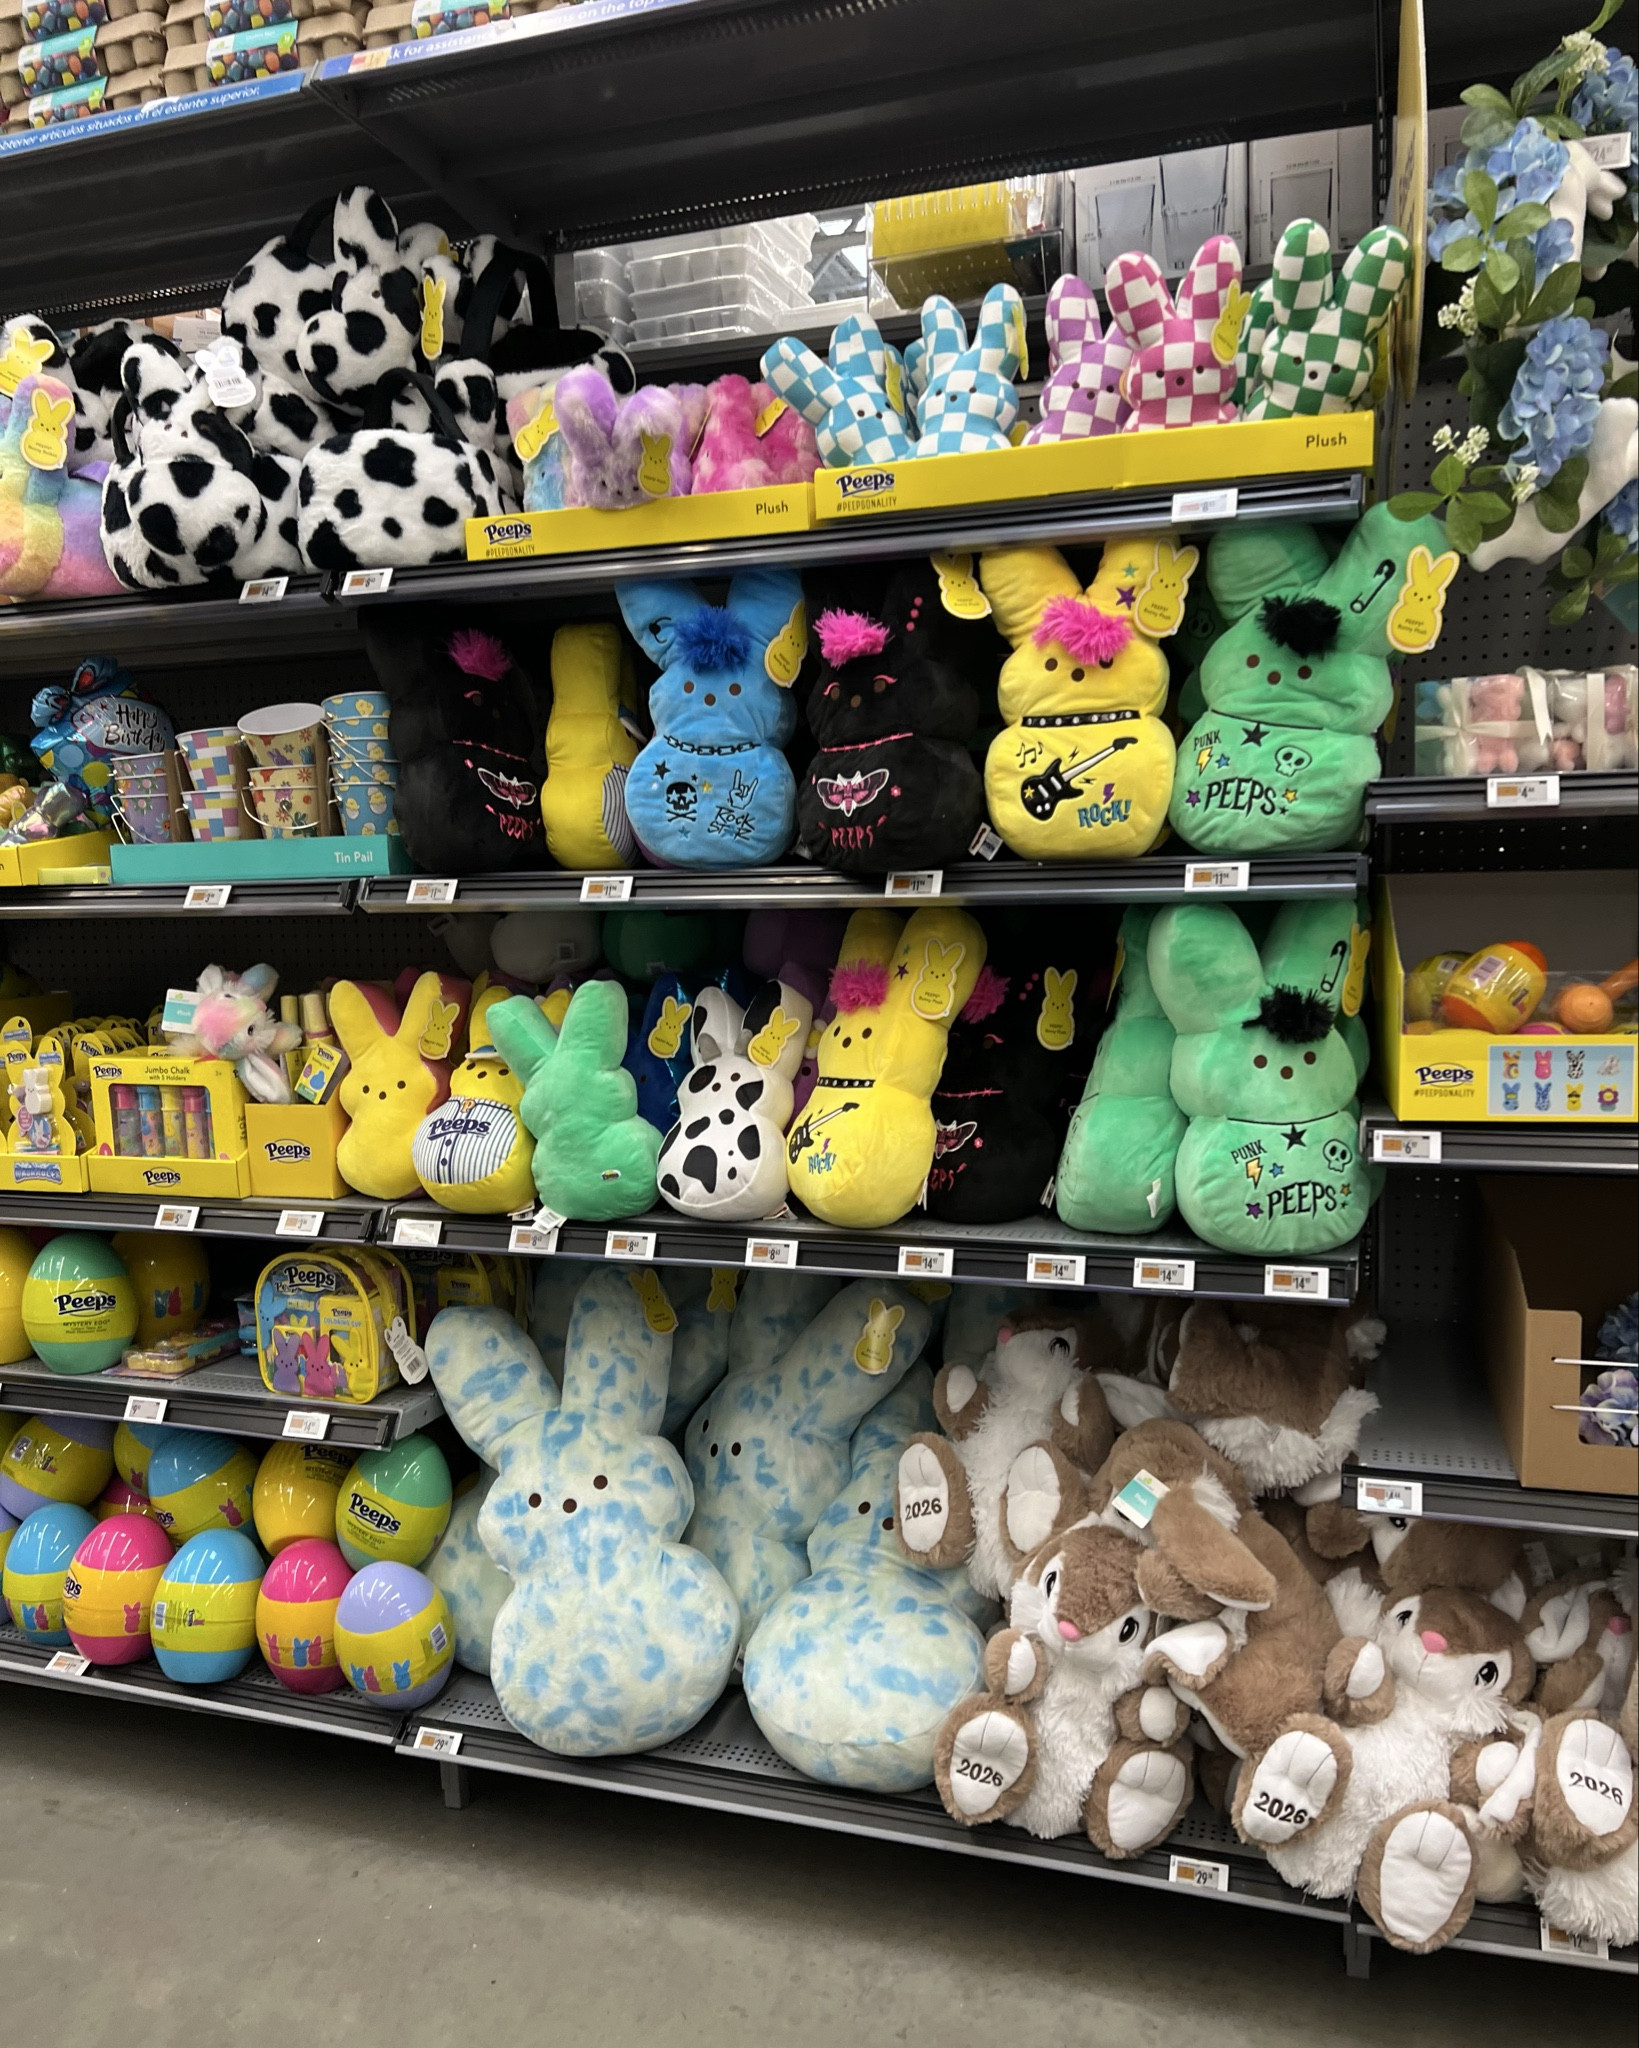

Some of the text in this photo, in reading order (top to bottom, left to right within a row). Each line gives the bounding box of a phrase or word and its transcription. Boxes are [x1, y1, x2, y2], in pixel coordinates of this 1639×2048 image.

[404, 43, 425, 58] for
[164, 97, 208, 115] estante
[1306, 432, 1347, 448] Plush
[836, 472, 895, 497] Peeps
[756, 501, 789, 515] Plush
[836, 497, 897, 513] #PEEPSONALITY
[484, 523, 532, 545] Peeps
[116, 703, 158, 729] Happy
[104, 723, 166, 751] Birthday
[1193, 731, 1222, 751] PUNK
[1204, 776, 1277, 817] PEEPS
[1077, 799, 1131, 828] ROCK!
[499, 811, 534, 841] PEEPS
[830, 825, 874, 850] PEEPS
[334, 851, 373, 864] Tin Pail
[80, 1040, 101, 1057] Peep
[93, 1065, 122, 1079] Peeps
[145, 1066, 190, 1075] Jumbo Chalk
[1415, 1065, 1474, 1086] Peeps
[1414, 1088, 1475, 1098] #PEEPSONALITY
[427, 1117, 492, 1141] Peeps
[264, 1142, 311, 1160] Peeps
[1230, 1138, 1267, 1164] PUNK
[143, 1170, 181, 1186] Peeps
[1266, 1180, 1337, 1220] PEEPS
[284, 1264, 335, 1288] Peeps
[53, 1293, 117, 1312] Peeps
[350, 1492, 402, 1532] Peeps
[904, 1498, 943, 1521] 2026
[955, 1757, 1005, 1788] 2026
[1568, 1771, 1624, 1806] 2026
[1253, 1791, 1309, 1824] 2026
